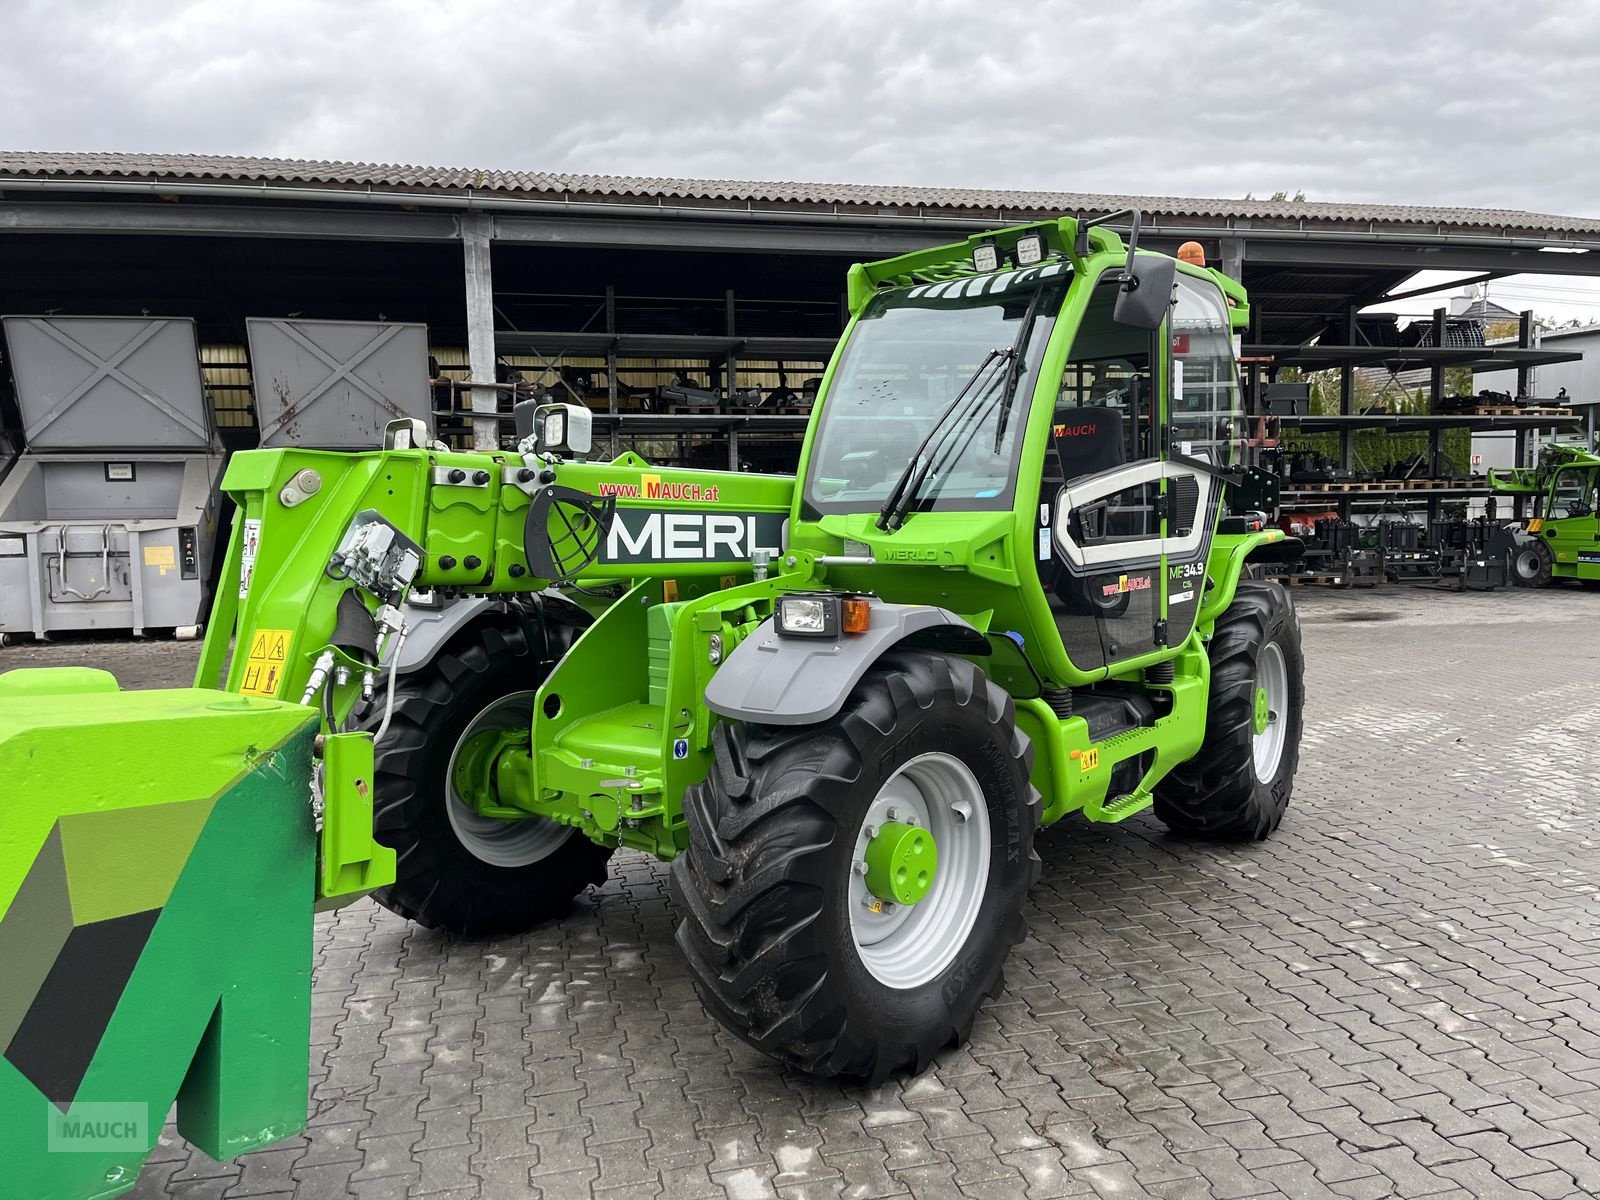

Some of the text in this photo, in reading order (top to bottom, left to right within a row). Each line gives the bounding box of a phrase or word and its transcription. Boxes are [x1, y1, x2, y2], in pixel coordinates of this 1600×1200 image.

[1055, 424, 1096, 437] MAUCH
[607, 512, 790, 559] MERL
[885, 548, 938, 561] MERLO
